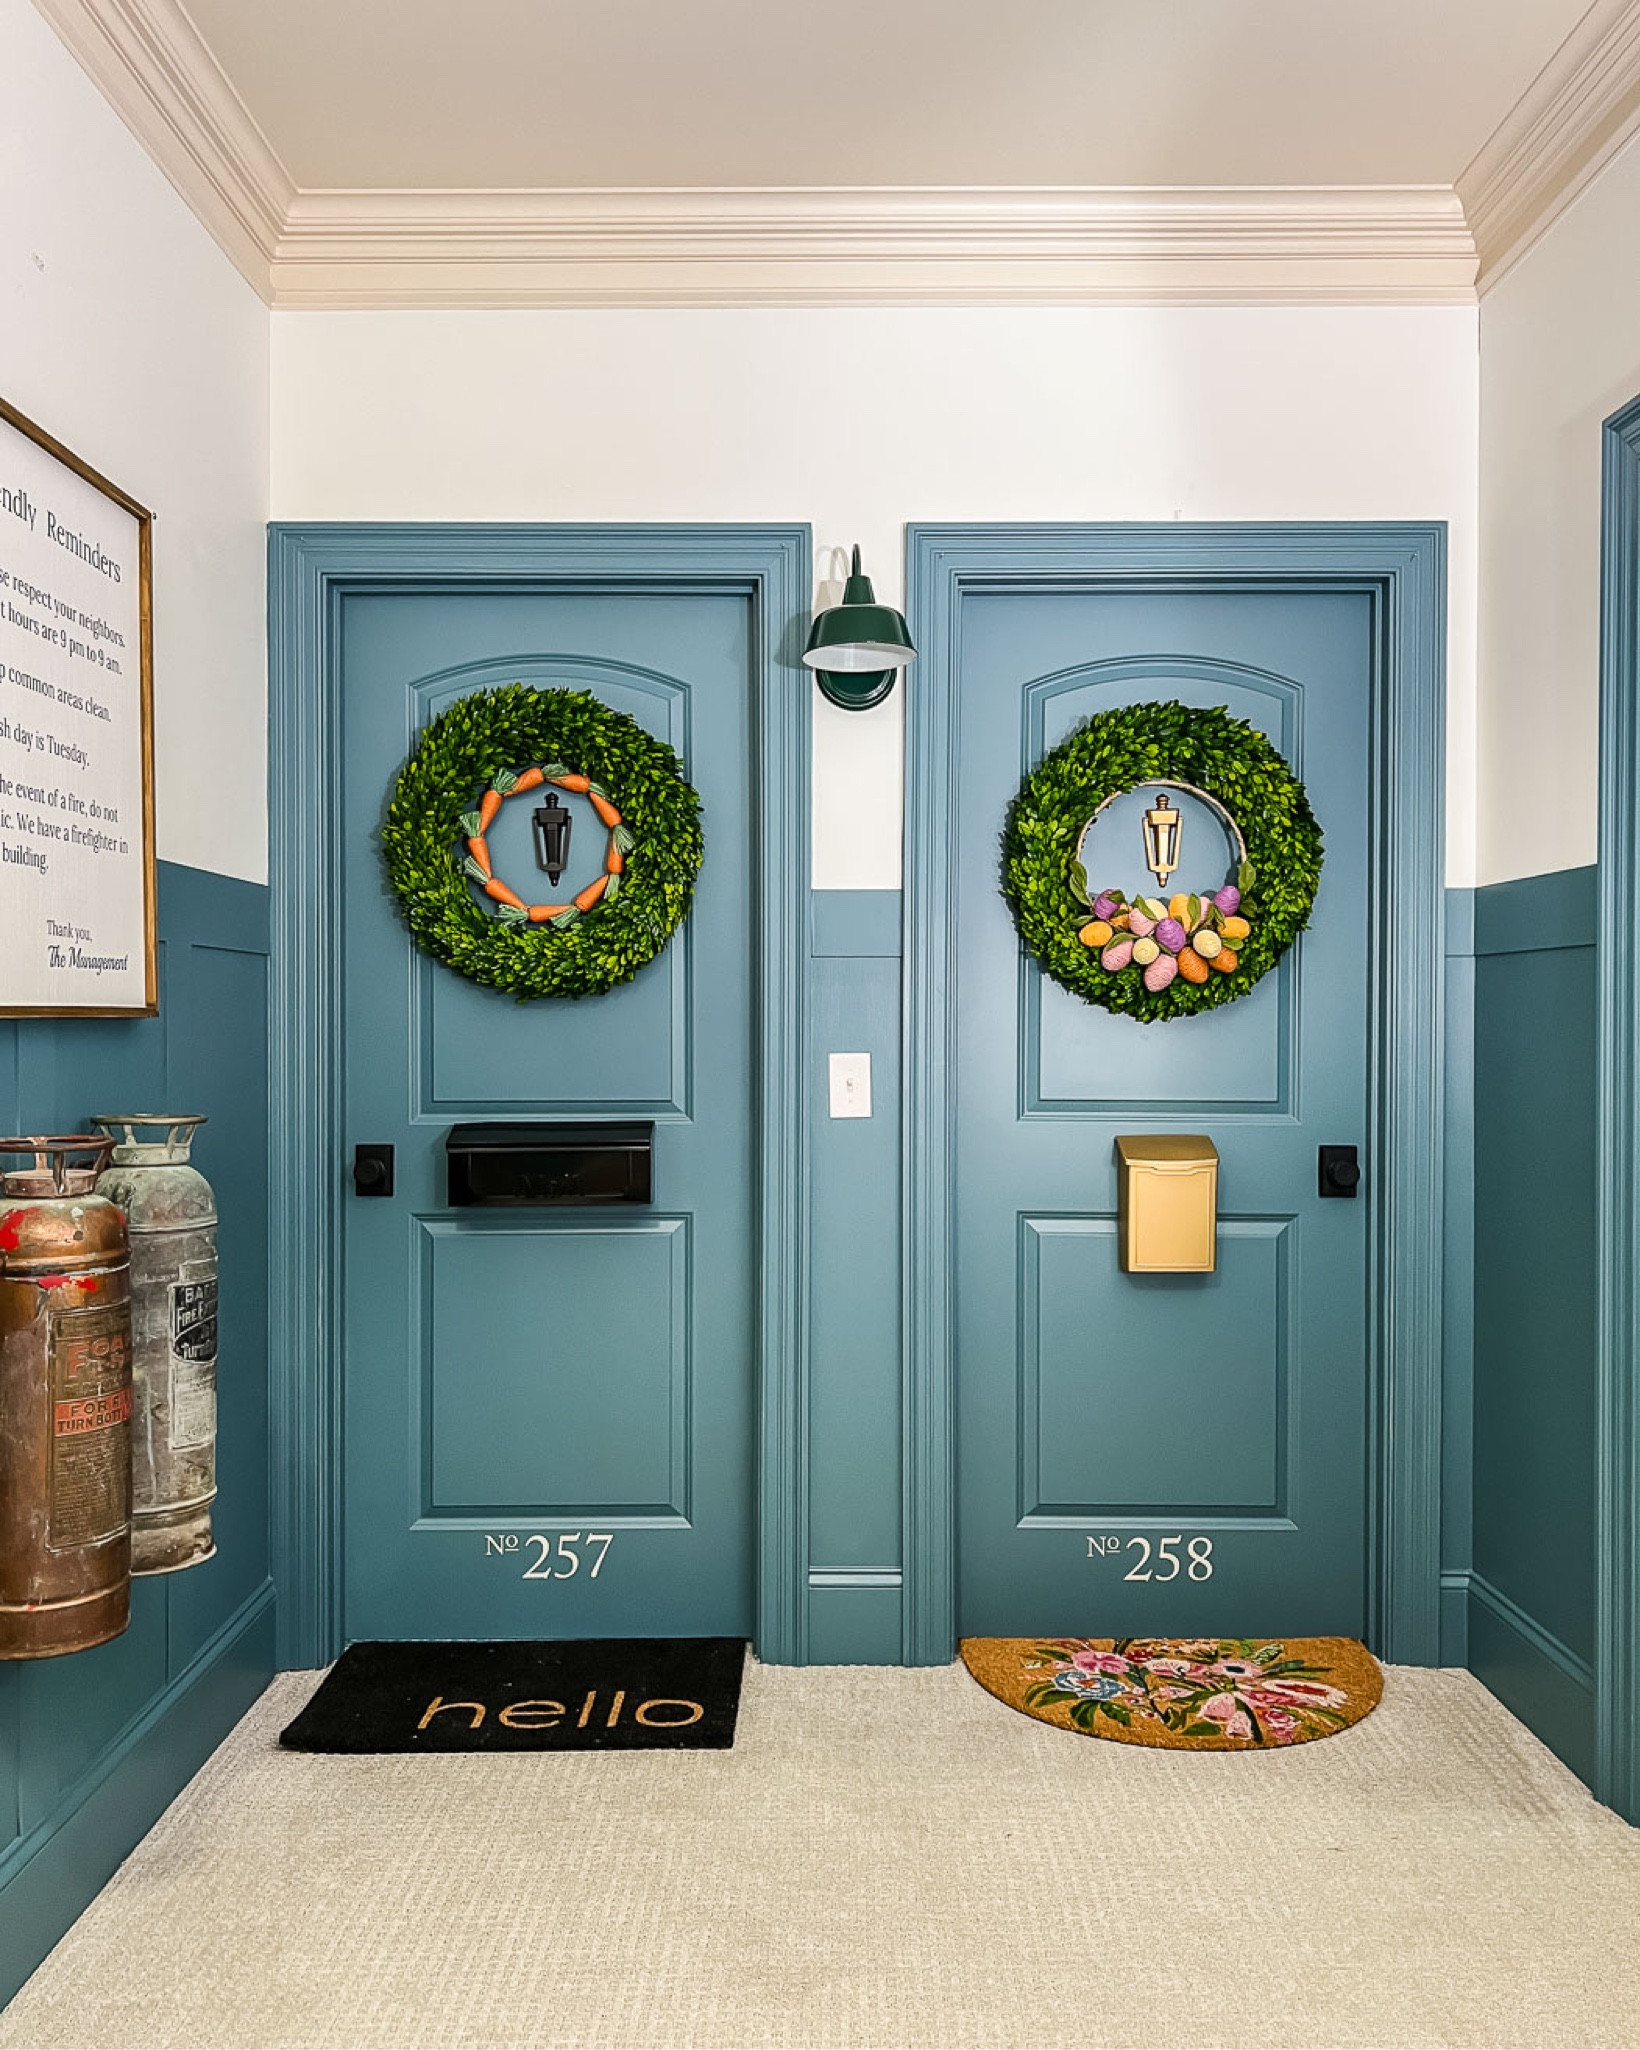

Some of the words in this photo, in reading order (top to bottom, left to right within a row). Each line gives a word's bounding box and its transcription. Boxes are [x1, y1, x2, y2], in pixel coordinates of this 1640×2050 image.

[0, 488, 36, 531] ndly
[47, 509, 121, 583] Reminders
[12, 576, 52, 610] respect
[54, 599, 77, 618] your
[79, 612, 125, 648] neighbors.
[8, 602, 39, 635] hours
[42, 624, 58, 644] are
[60, 629, 66, 648] 9
[69, 638, 85, 658] pm
[86, 645, 97, 662] to
[98, 648, 104, 667] 9
[106, 657, 122, 675] am.
[8, 667, 55, 699] common
[57, 688, 83, 711] areas
[85, 696, 112, 722] clean.
[14, 723, 33, 752] day
[36, 730, 44, 751] is
[46, 734, 90, 770] Tuesday.
[15, 783, 45, 804] event
[47, 788, 59, 807] of
[60, 794, 66, 810] a
[68, 792, 88, 818] fire,
[89, 800, 102, 818] do
[103, 807, 118, 823] not
[16, 812, 35, 834] We
[37, 816, 61, 840] have
[63, 827, 69, 842] a
[71, 824, 118, 854] firefighter
[119, 836, 128, 854] in
[2, 841, 49, 875] building.
[46, 919, 73, 938] Thank
[74, 927, 93, 944] you,
[47, 944, 66, 968] The
[68, 946, 128, 976] Management
[57, 1417, 93, 1433] TURN
[71, 1400, 107, 1417] FOR
[522, 1531, 614, 1580] 257
[1123, 1534, 1213, 1582] 258
[417, 1690, 705, 1730] hello
